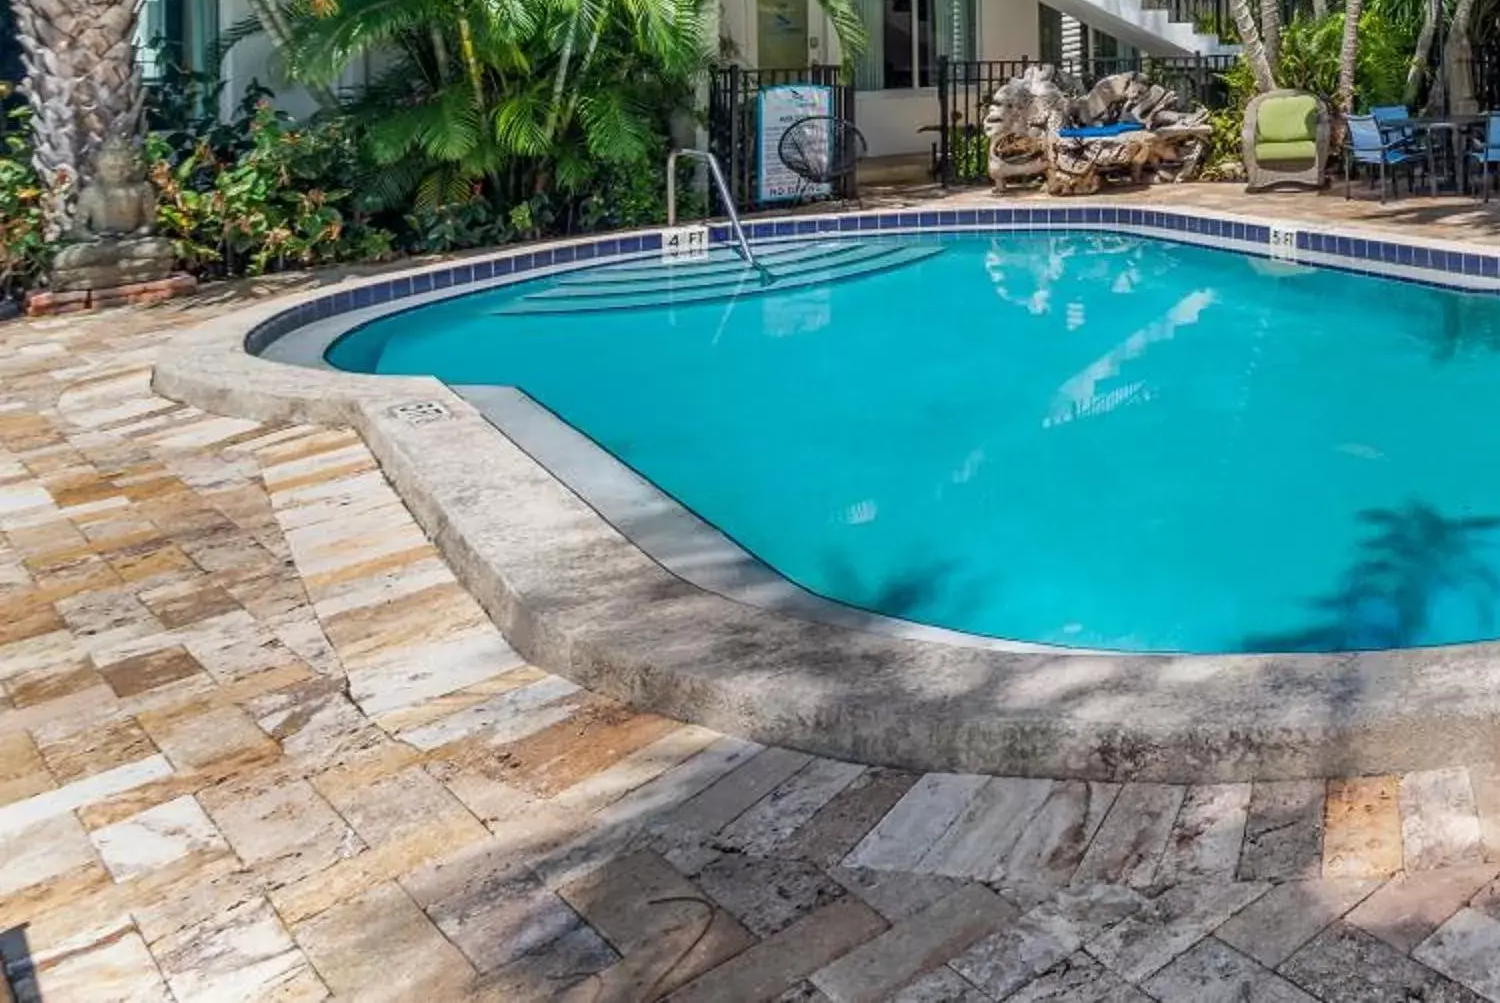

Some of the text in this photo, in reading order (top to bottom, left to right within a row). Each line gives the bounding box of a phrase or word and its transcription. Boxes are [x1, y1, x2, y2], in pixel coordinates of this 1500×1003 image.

[668, 231, 705, 248] 4 FT
[1272, 229, 1293, 246] 5 FT
